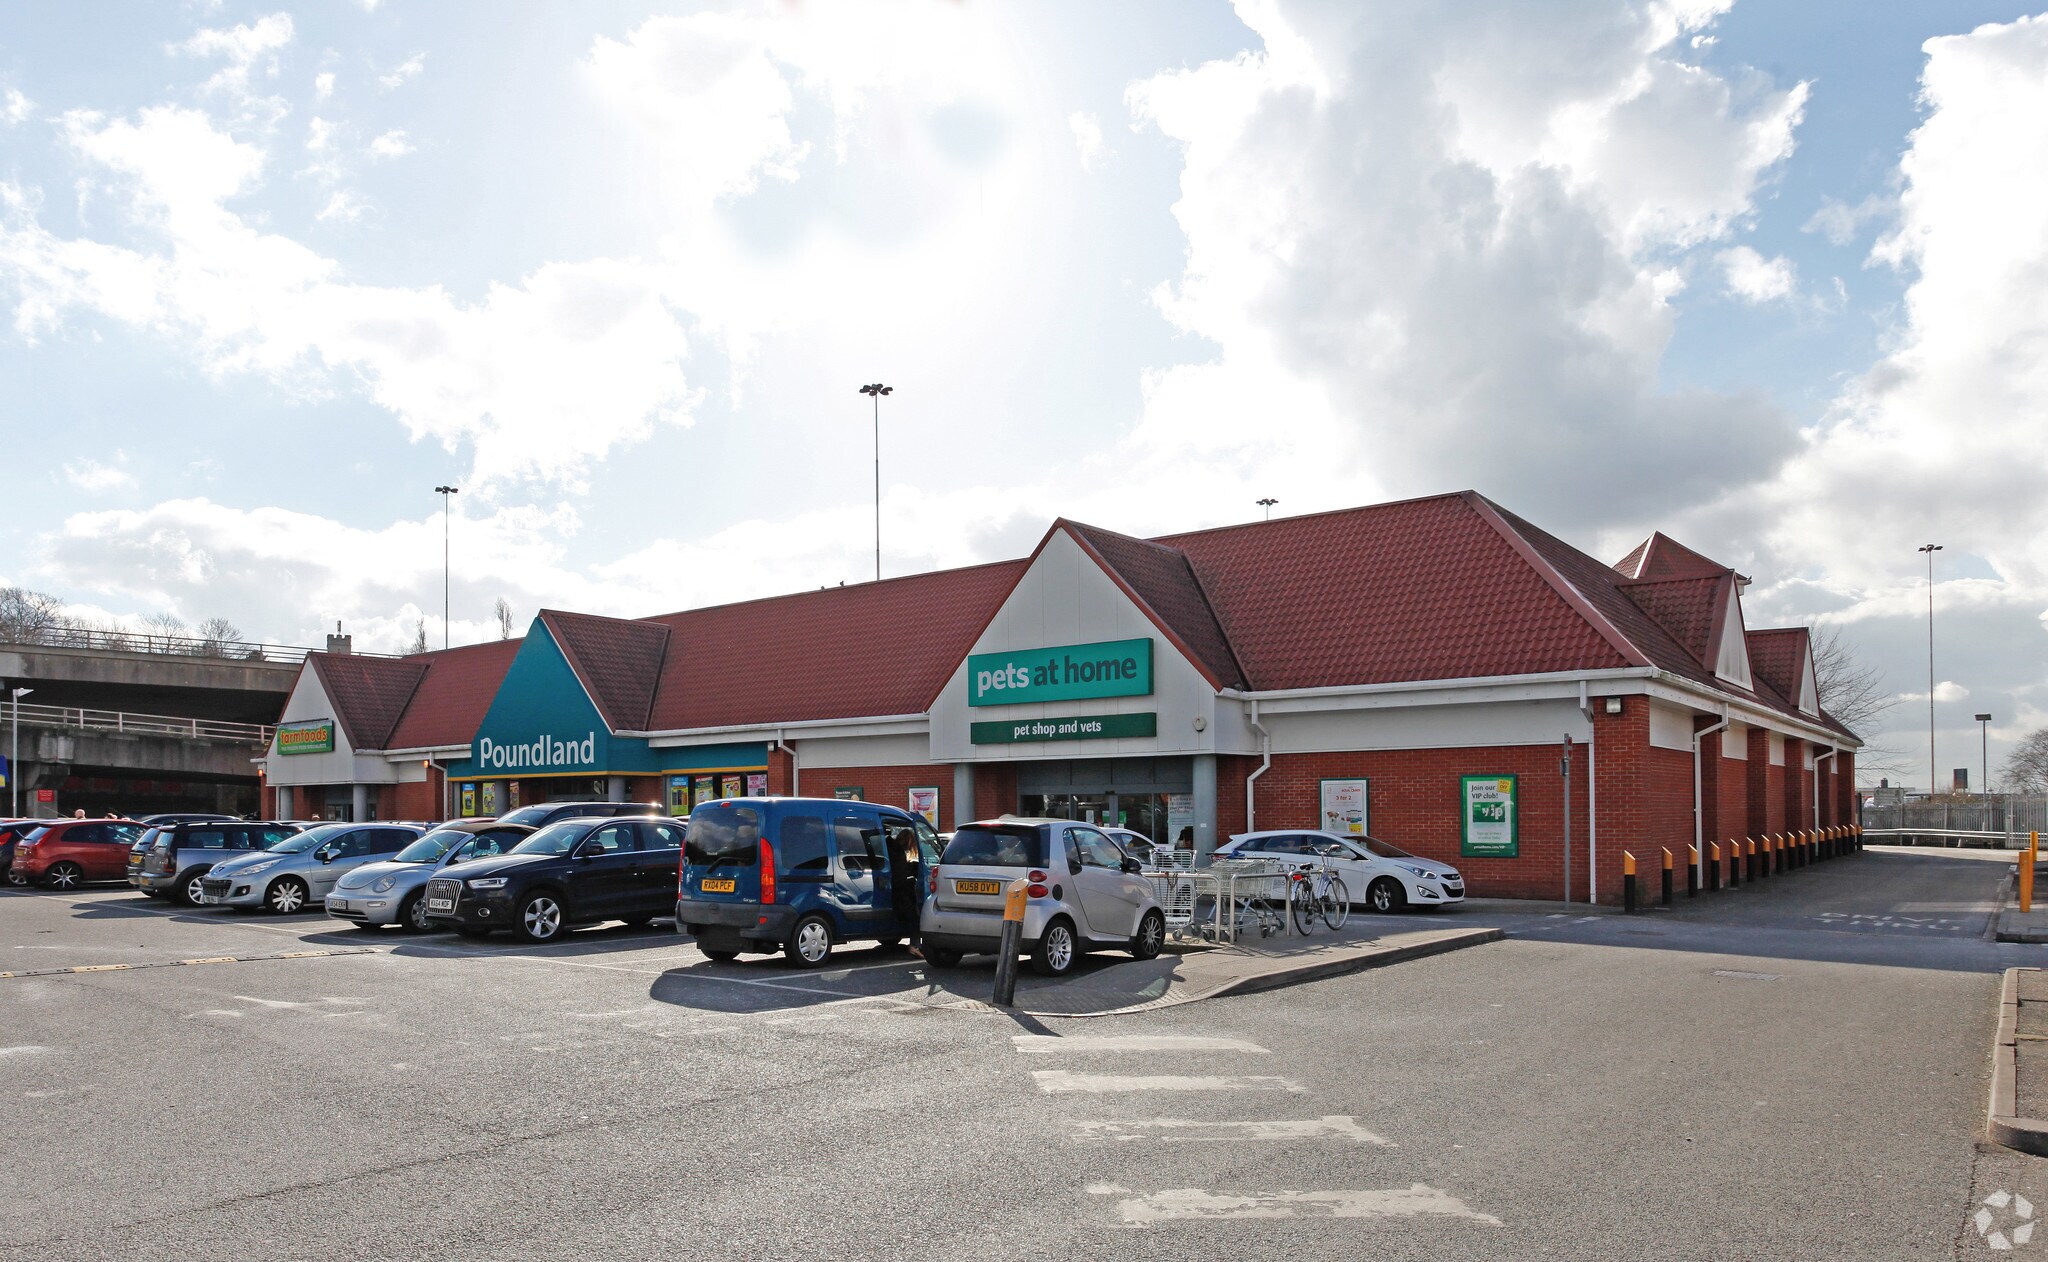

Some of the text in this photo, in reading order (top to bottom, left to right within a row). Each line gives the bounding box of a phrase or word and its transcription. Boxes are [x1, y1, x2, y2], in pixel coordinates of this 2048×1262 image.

[977, 654, 1137, 698] pets at home
[280, 728, 327, 745] farmfoods
[1014, 720, 1102, 739] pet shop and vets
[480, 731, 595, 768] Poundland
[1482, 803, 1504, 820] vip
[704, 881, 732, 890] RX04 PCF
[959, 882, 996, 892] KU58 OVT
